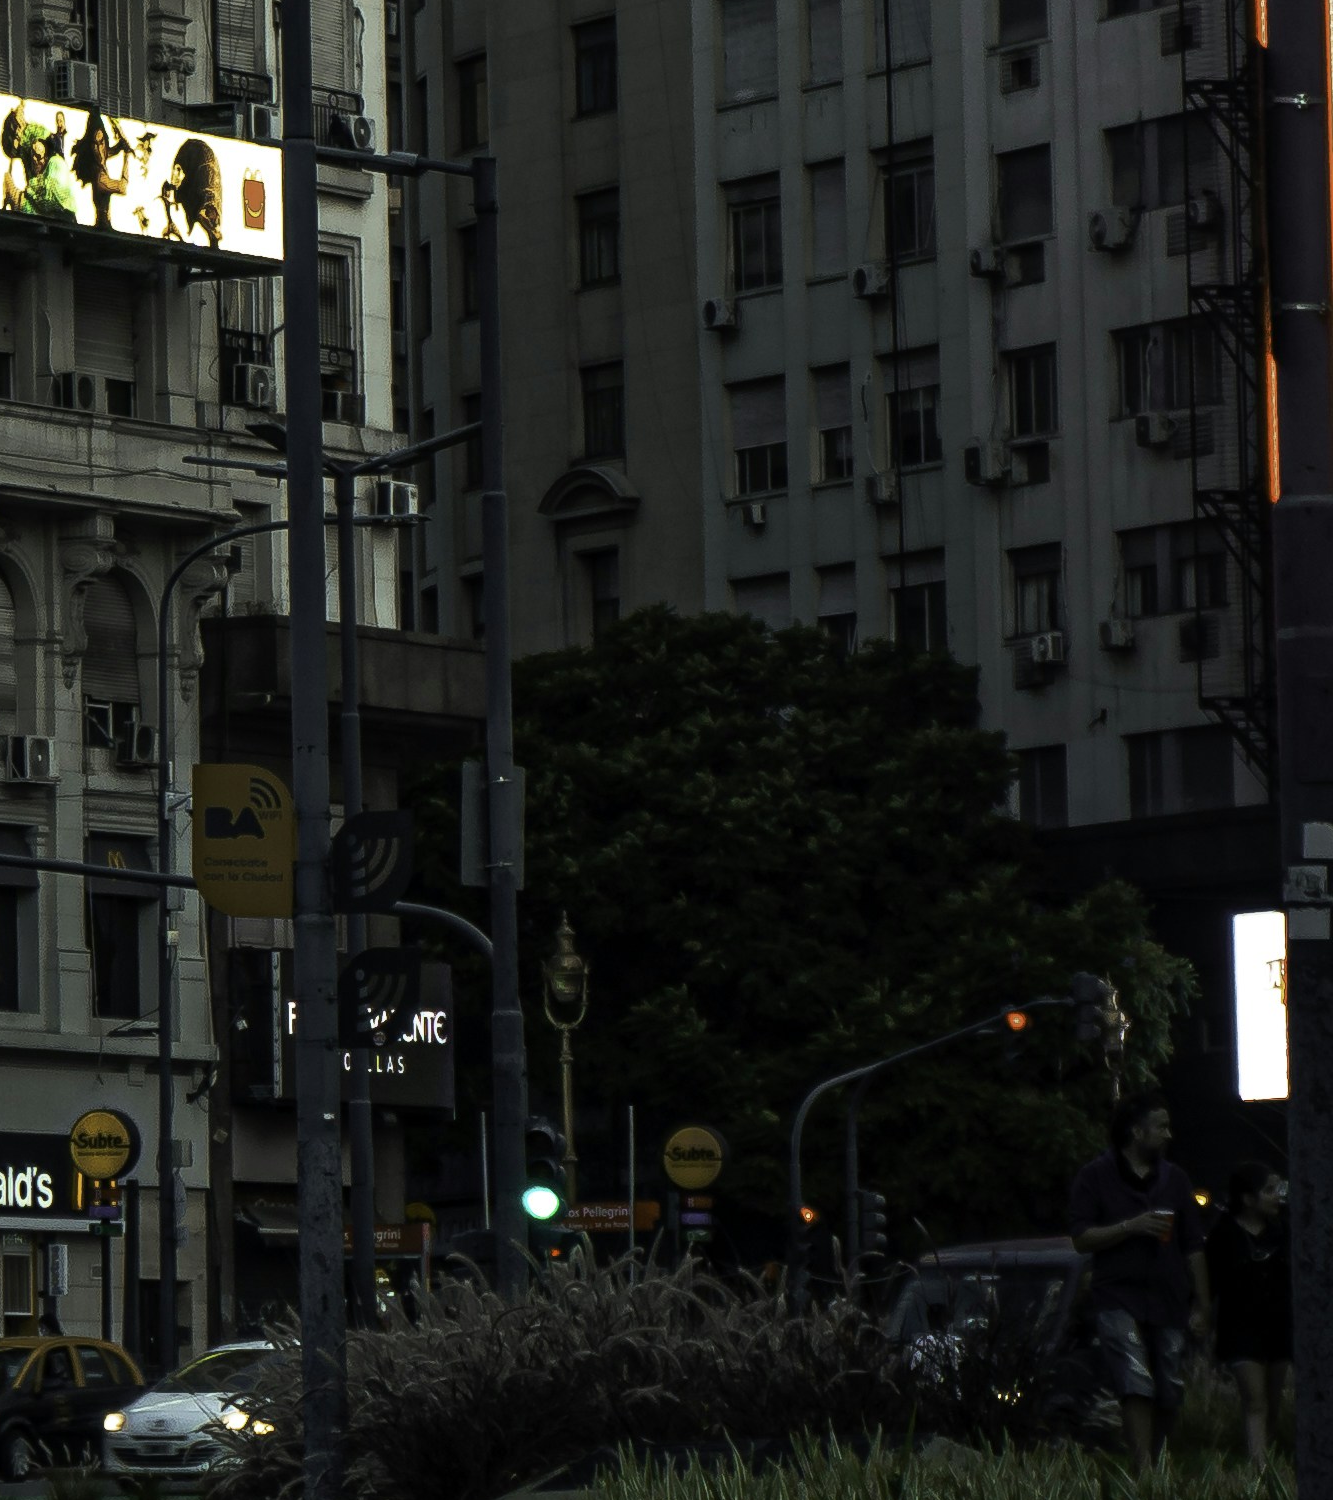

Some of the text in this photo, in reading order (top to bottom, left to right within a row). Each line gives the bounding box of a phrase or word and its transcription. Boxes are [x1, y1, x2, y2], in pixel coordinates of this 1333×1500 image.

[205, 807, 265, 839] BA
[77, 1132, 124, 1149] Subte
[670, 1147, 715, 1161] Subte
